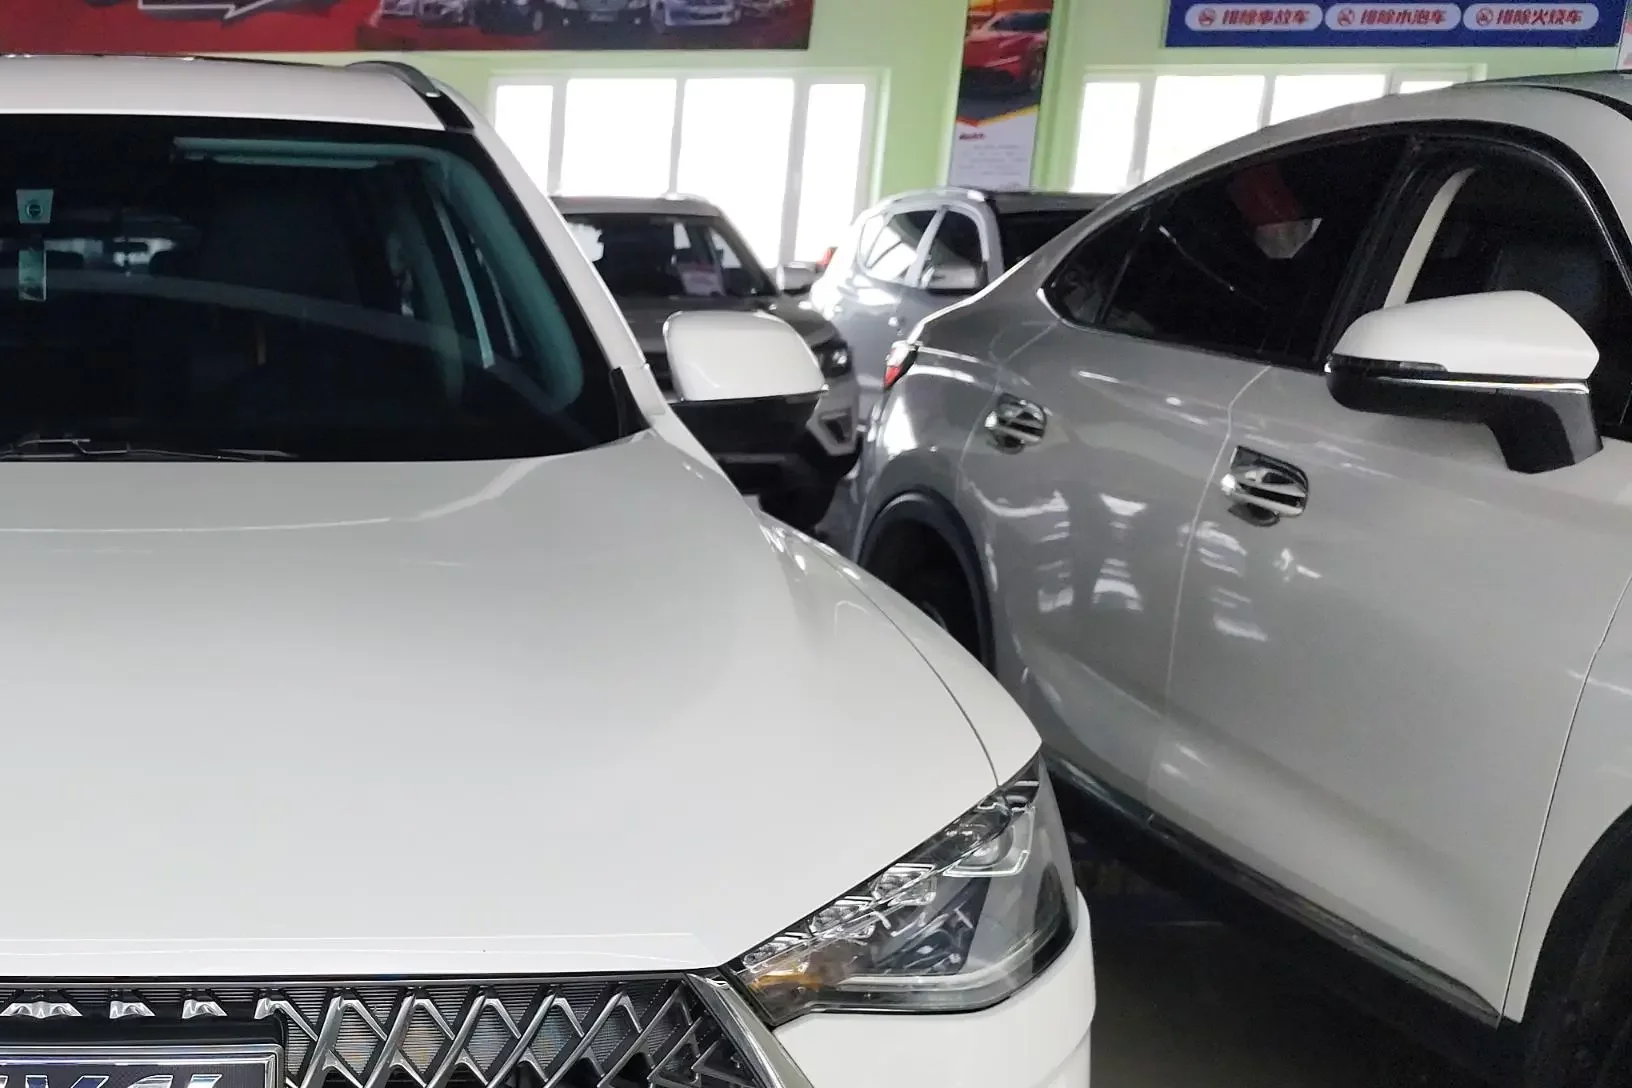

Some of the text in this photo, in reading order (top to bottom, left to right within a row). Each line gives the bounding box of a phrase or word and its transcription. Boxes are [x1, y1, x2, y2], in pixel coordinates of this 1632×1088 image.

[1496, 8, 1583, 25] 排除火烧车
